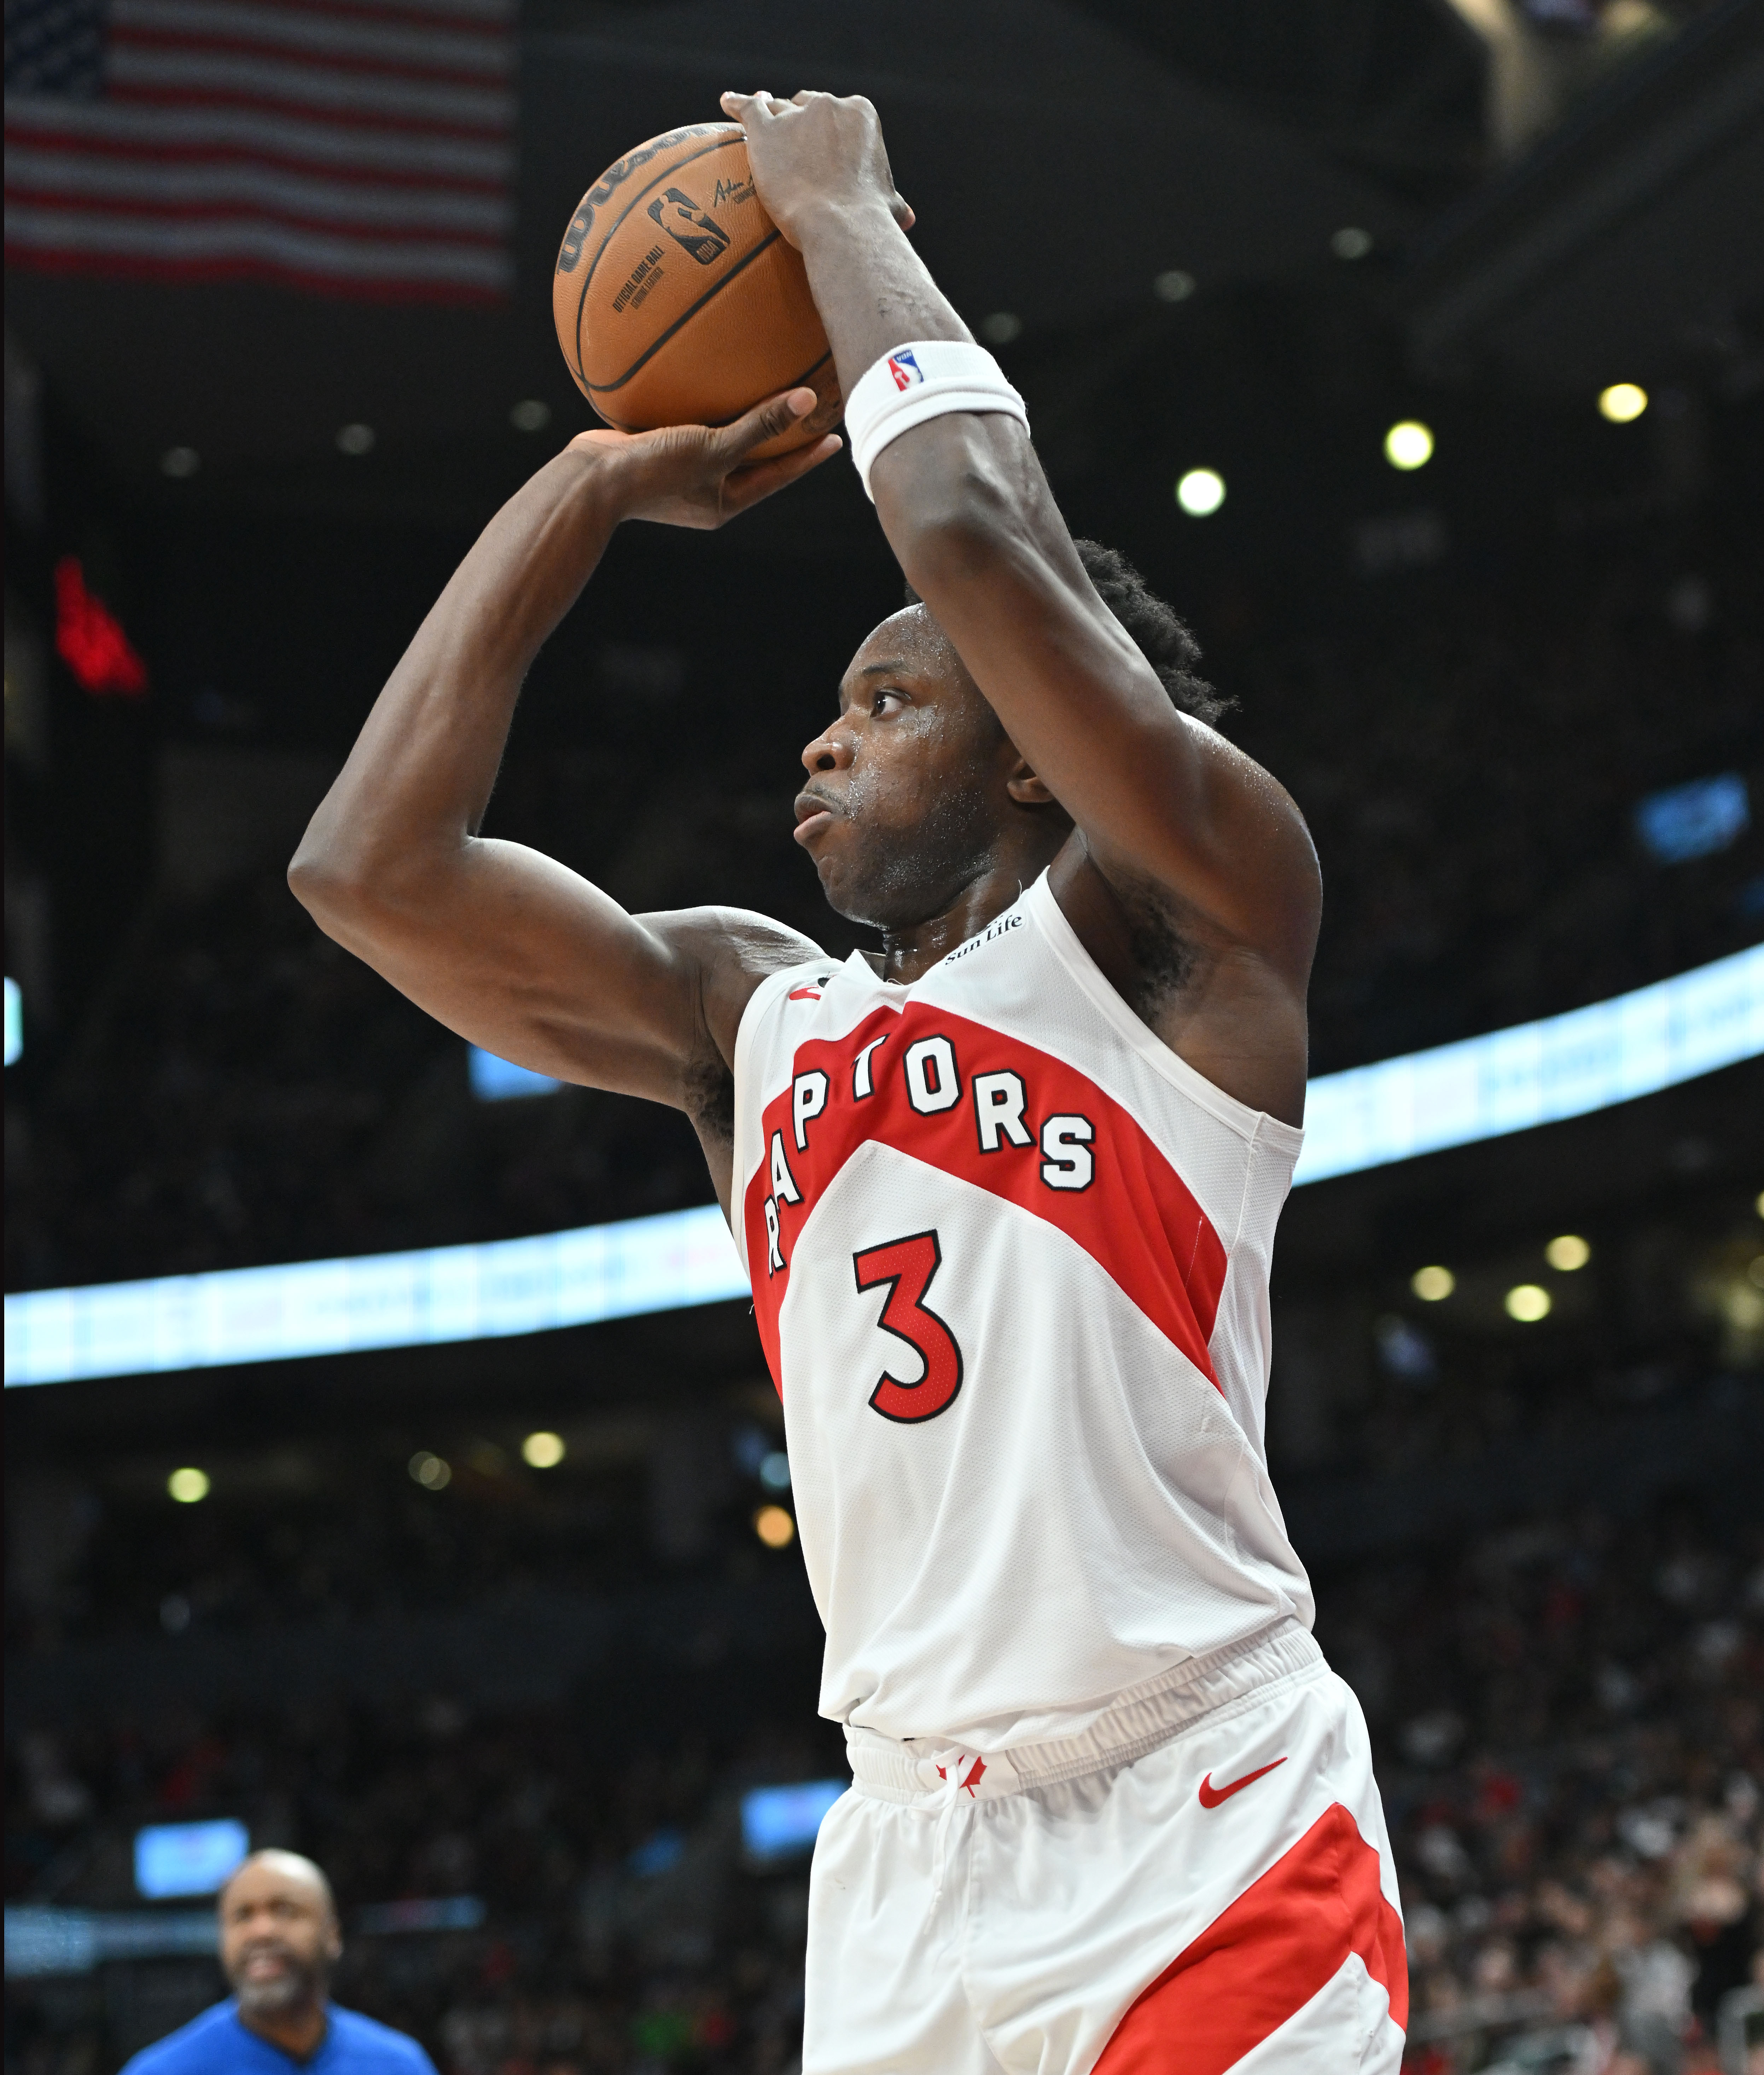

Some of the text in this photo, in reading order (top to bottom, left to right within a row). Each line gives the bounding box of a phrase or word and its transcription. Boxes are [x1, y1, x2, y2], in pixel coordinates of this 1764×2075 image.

[612, 245, 665, 313] OFFICIAL GAME BALL
[696, 240, 719, 262] NBA
[945, 914, 1023, 965] Sun Life
[763, 1033, 1096, 1278] RAPTORS
[853, 1228, 964, 1424] 3
